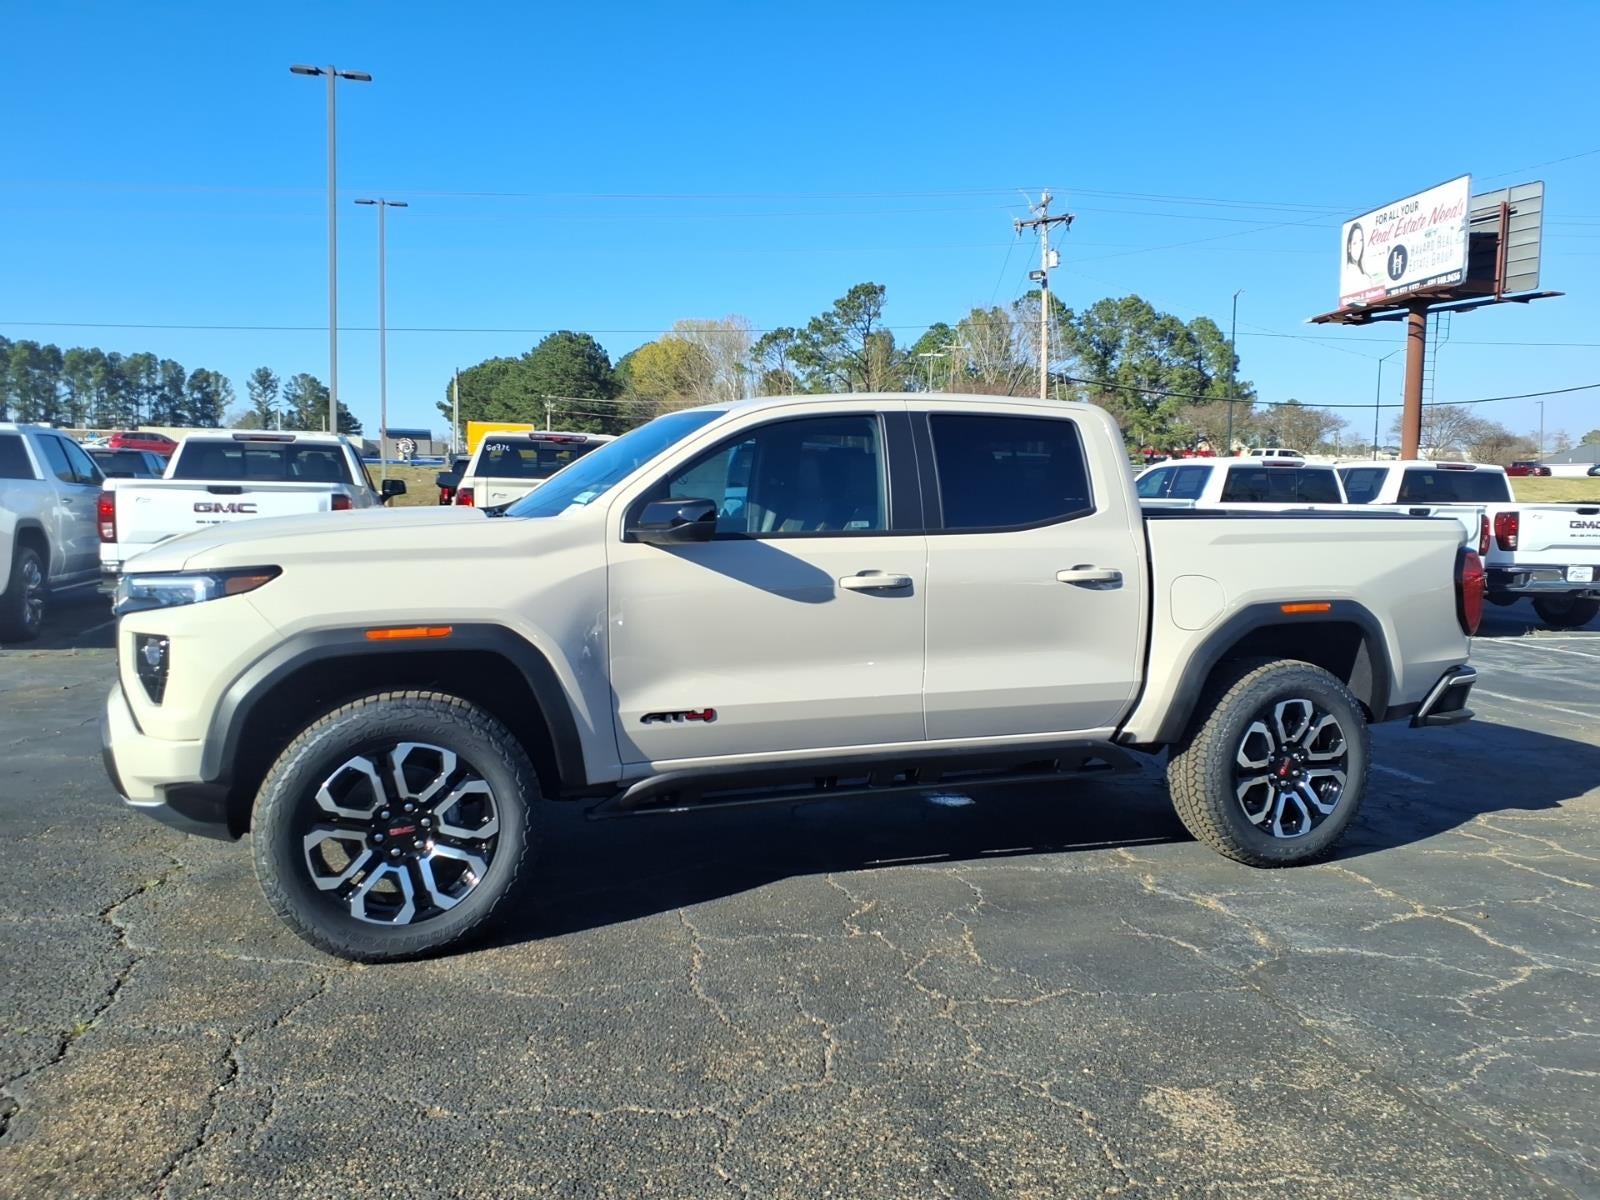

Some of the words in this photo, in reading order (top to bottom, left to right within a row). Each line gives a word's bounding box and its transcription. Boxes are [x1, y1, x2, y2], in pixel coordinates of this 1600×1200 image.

[1368, 223, 1394, 247] Real
[1394, 213, 1427, 238] Estate
[1428, 198, 1464, 226] Needs
[1375, 212, 1388, 226] FOR
[1388, 208, 1400, 221] ALL
[1401, 200, 1420, 216] YOUR
[193, 502, 257, 514] GMC
